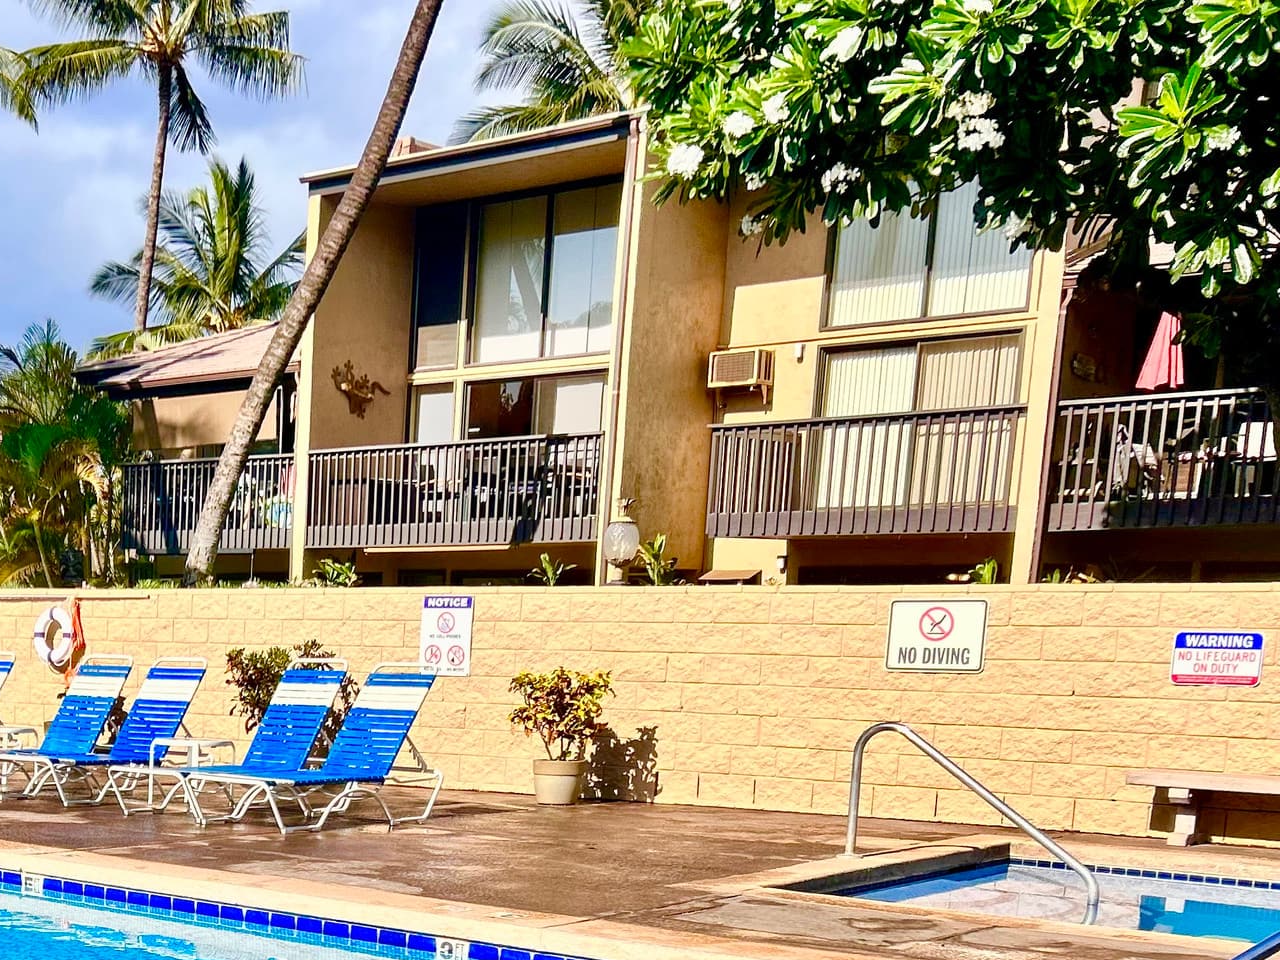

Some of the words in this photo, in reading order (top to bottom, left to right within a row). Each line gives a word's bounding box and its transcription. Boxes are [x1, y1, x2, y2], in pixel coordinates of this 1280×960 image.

[427, 597, 469, 608] NOTICE
[1185, 634, 1254, 648] WARNING
[897, 647, 917, 664] NO
[922, 647, 970, 665] DIVING
[1178, 651, 1192, 661] NO
[1196, 651, 1256, 662] LIFEGUARD
[1193, 663, 1207, 673] ON
[1211, 663, 1239, 673] DUTY
